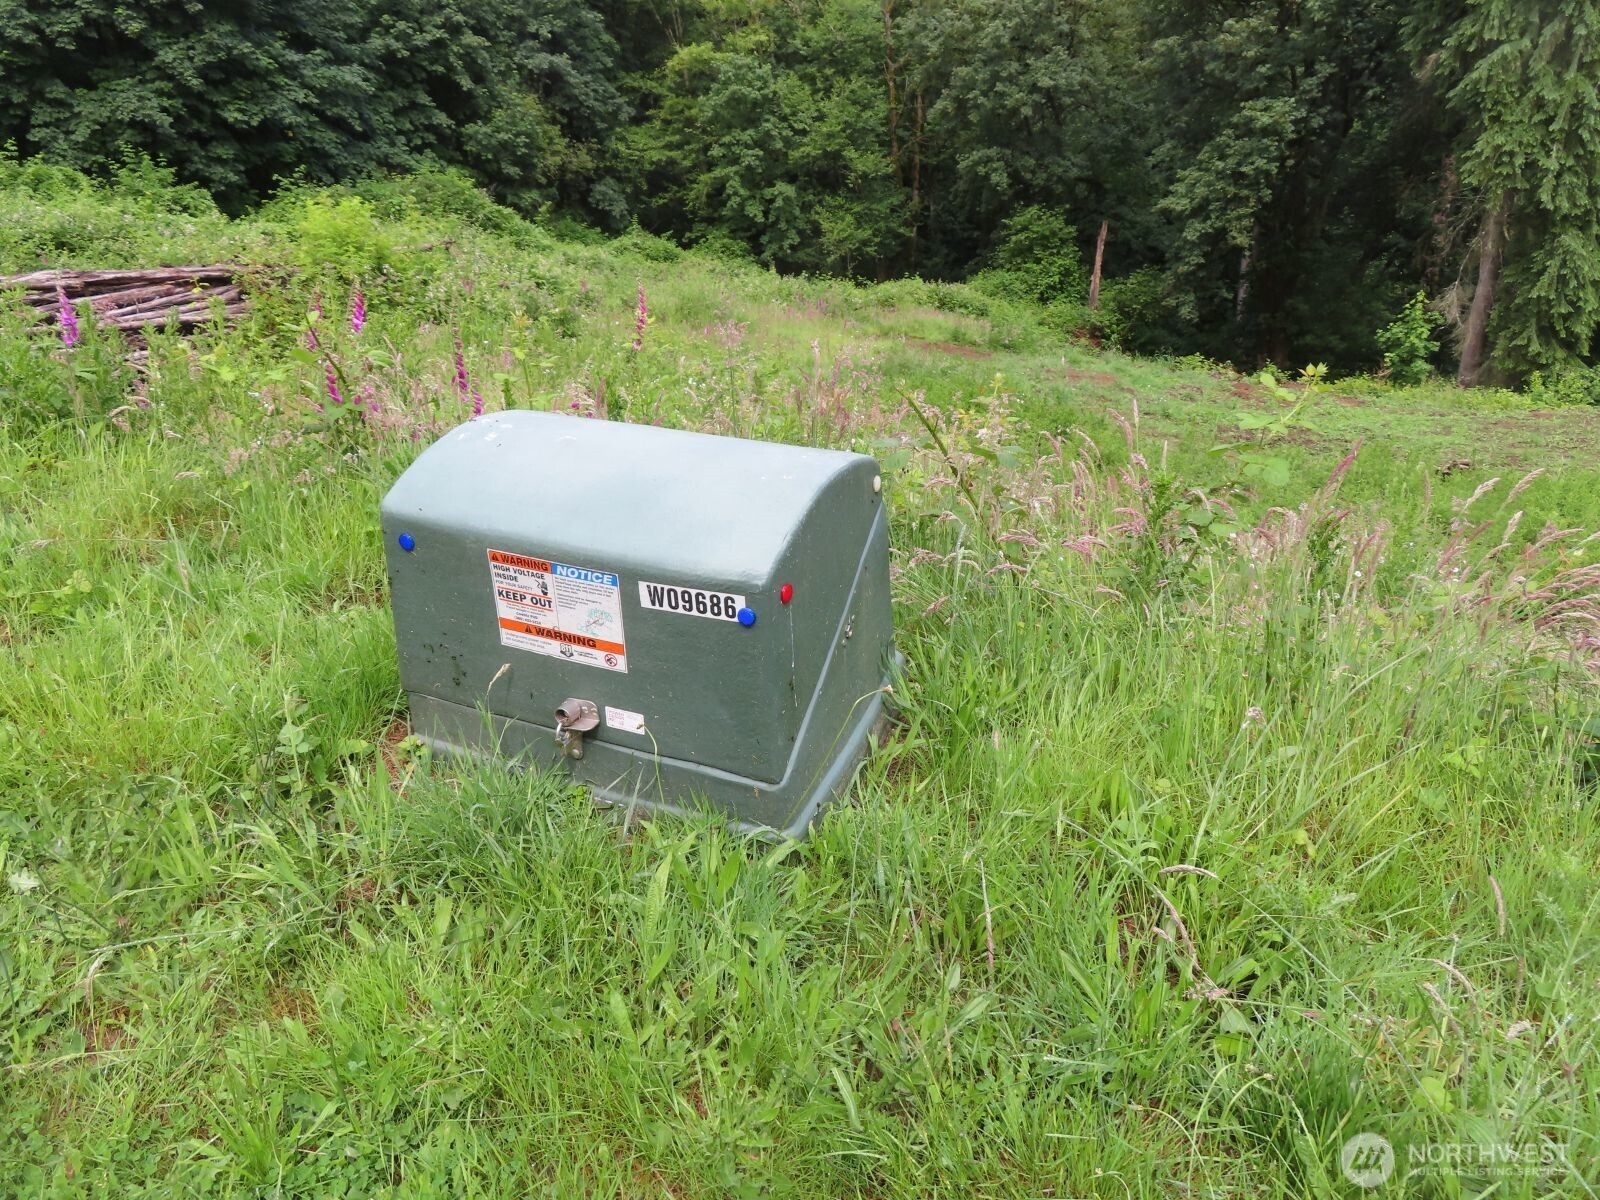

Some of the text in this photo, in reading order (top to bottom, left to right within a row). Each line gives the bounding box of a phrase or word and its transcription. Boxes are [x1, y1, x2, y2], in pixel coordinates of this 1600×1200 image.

[493, 564, 545, 580] HIGH VOLTAGE
[501, 554, 549, 572] WARNING
[494, 572, 519, 582] INSIDE
[557, 565, 613, 585] NOTICE
[497, 589, 527, 602] KEEP
[530, 596, 553, 609] OUT
[646, 584, 737, 619] W09686
[535, 626, 597, 648] WARNING
